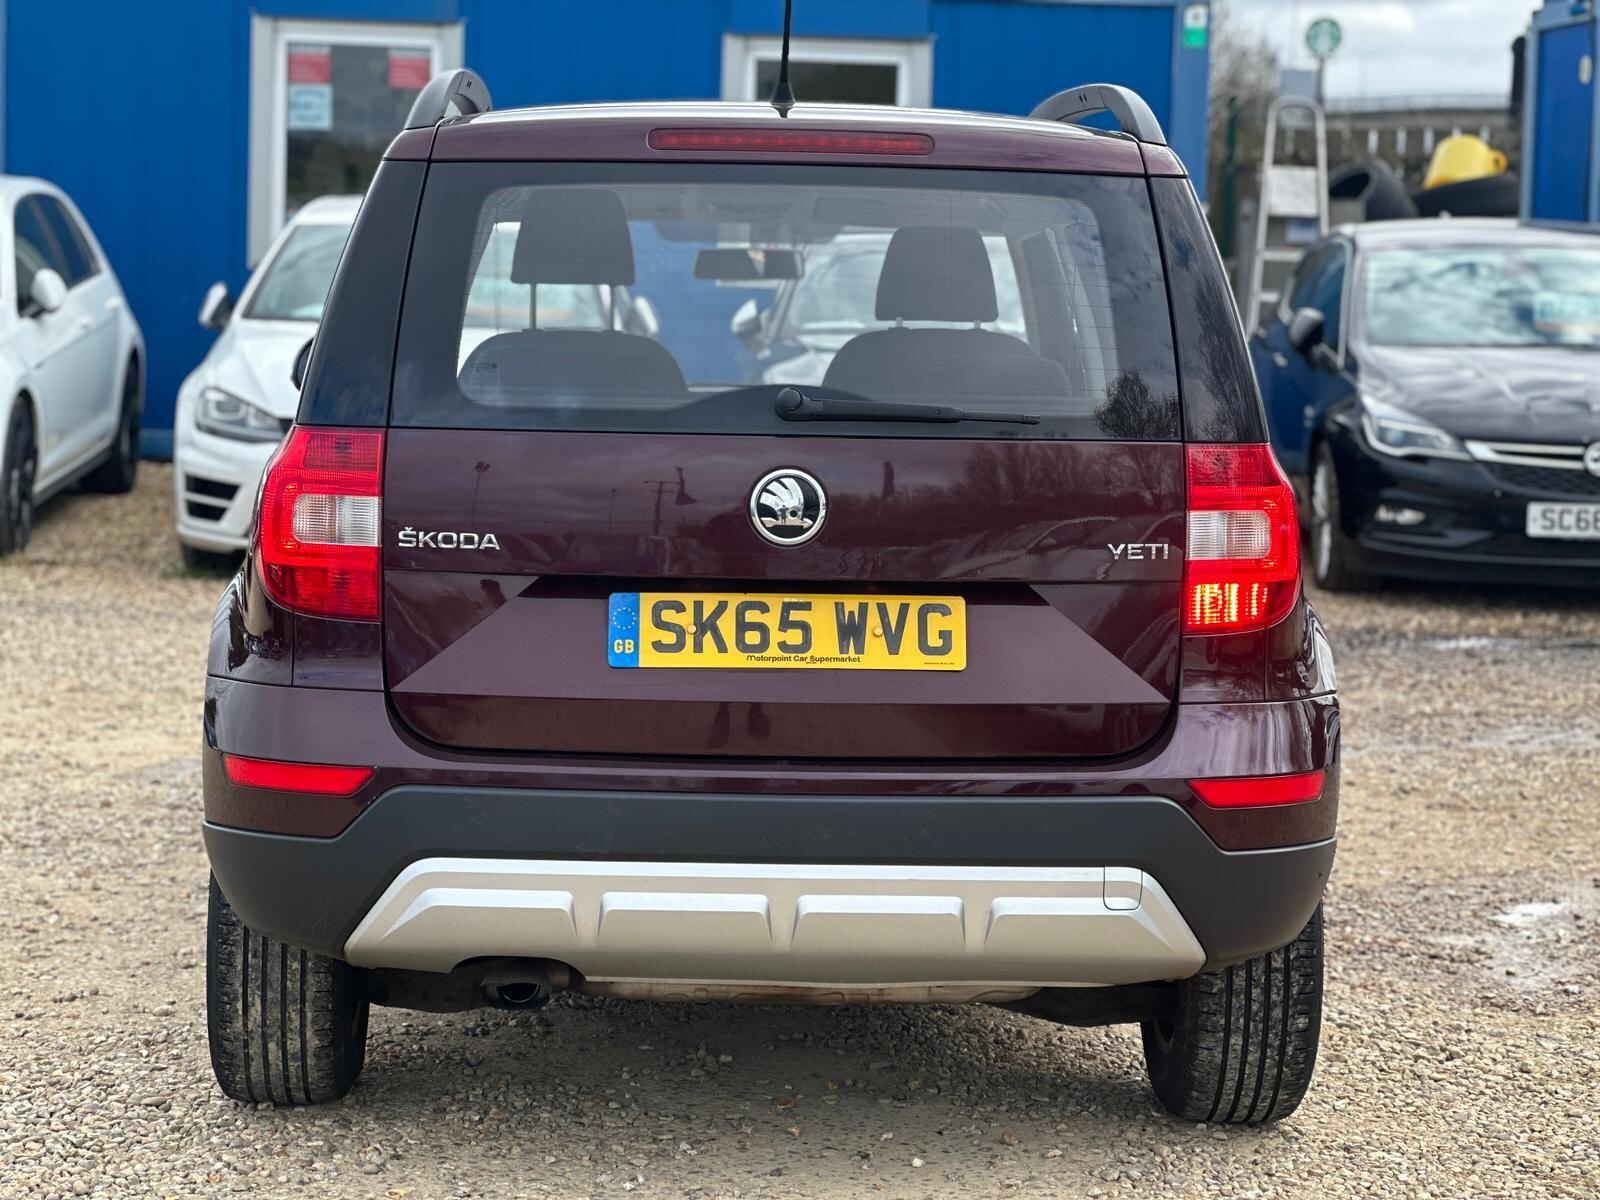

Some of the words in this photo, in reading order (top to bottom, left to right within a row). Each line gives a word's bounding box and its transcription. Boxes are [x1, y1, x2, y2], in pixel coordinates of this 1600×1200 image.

[398, 526, 501, 551] ŠKODA
[1107, 543, 1169, 560] YETI
[651, 599, 812, 654] SK65
[834, 601, 953, 656] WVG
[613, 639, 635, 654] GB
[746, 654, 792, 663] Motorpoint
[810, 655, 861, 663] Supermarket
